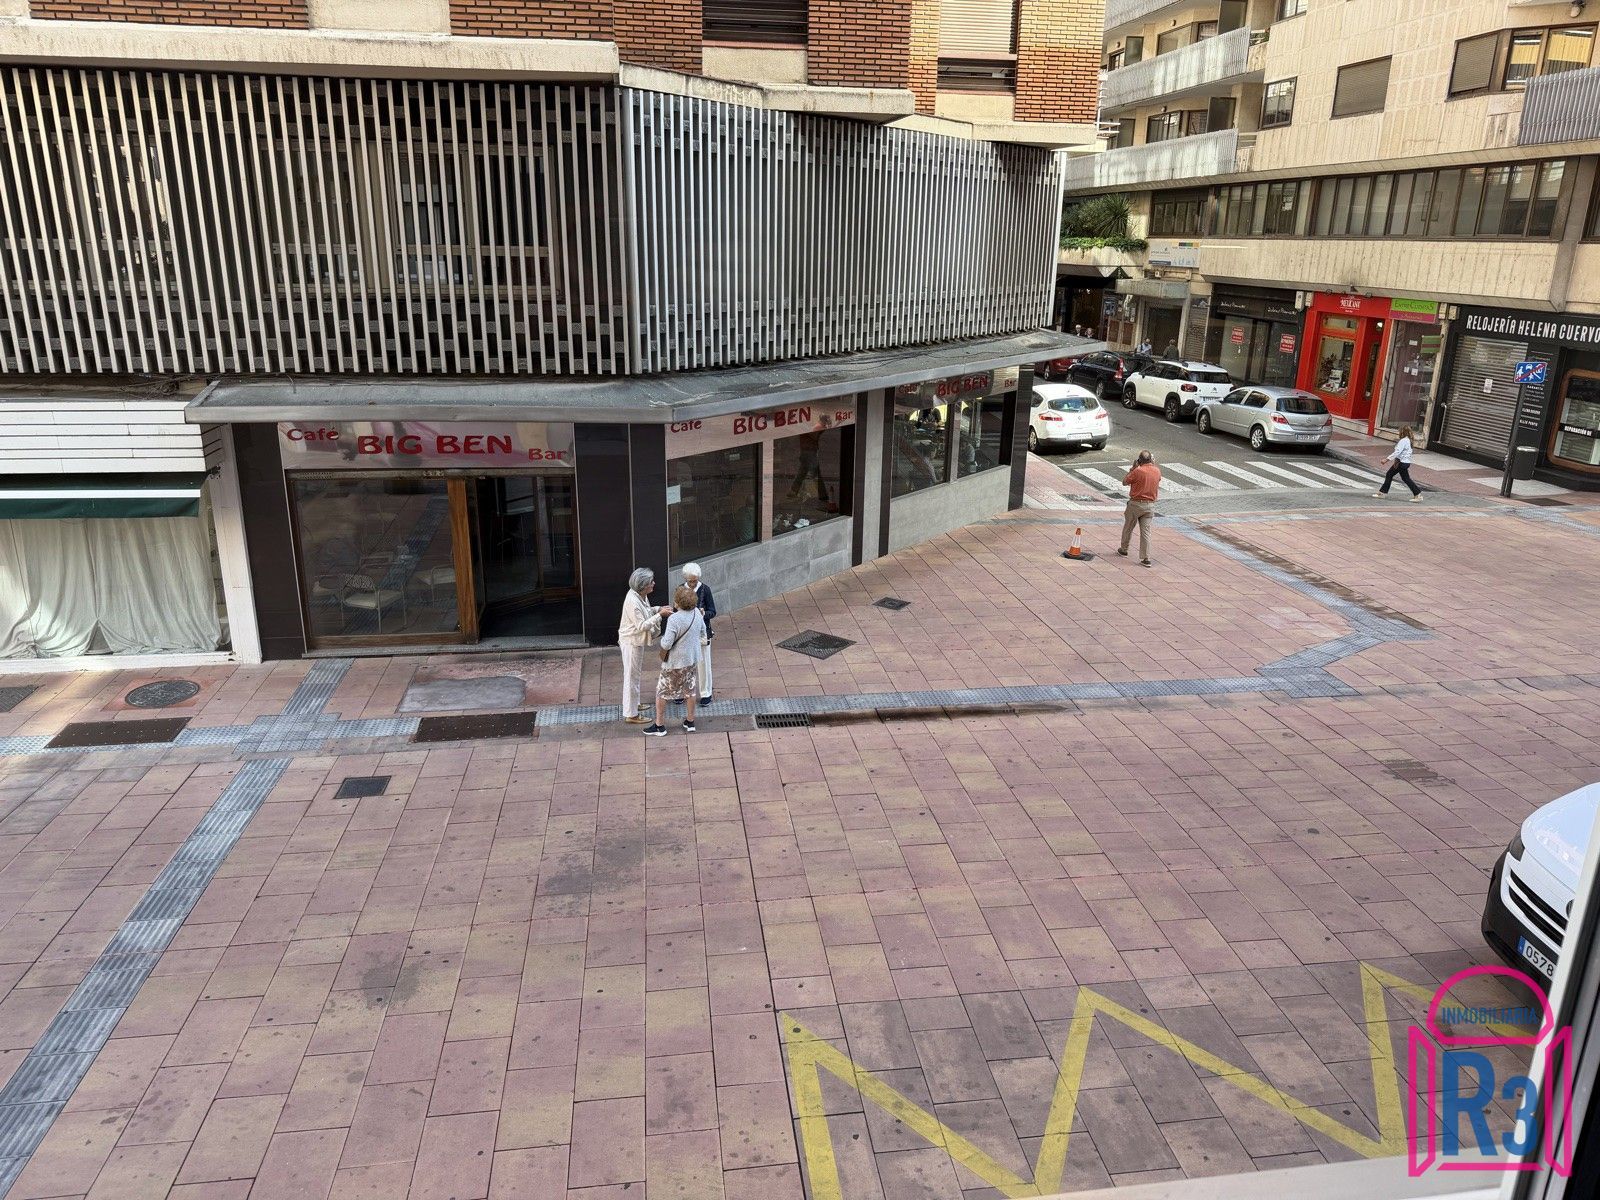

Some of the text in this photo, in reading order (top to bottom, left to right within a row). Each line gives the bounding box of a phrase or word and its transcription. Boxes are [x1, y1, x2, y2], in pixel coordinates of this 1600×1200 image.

[1466, 315, 1600, 343] RELOJERÍA HELENA CUERVO
[937, 380, 960, 397] BIG
[963, 375, 988, 392] BEN
[1004, 379, 1017, 388] Bar
[733, 415, 768, 436] BIG
[773, 406, 811, 428] BEN
[835, 410, 853, 422] Bar
[286, 426, 567, 461] Café BIG BEN Bar
[1525, 944, 1554, 977] 0578
